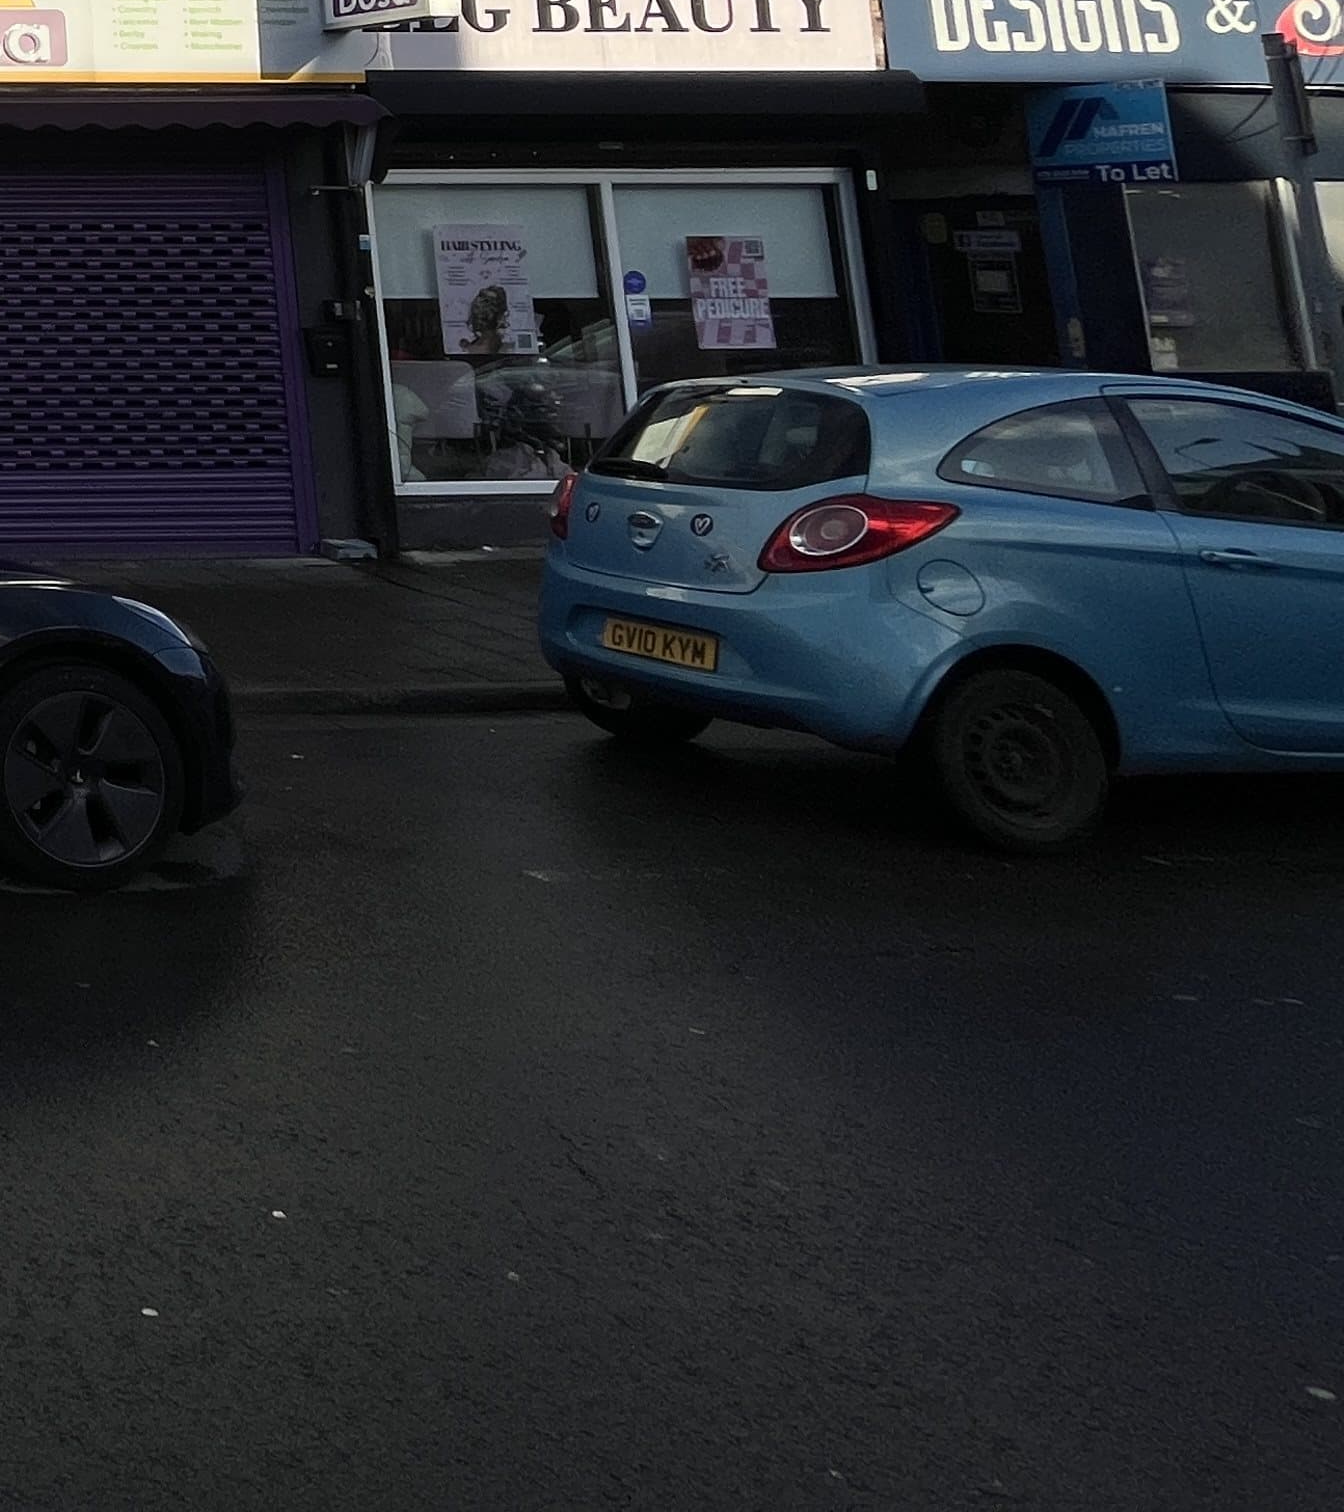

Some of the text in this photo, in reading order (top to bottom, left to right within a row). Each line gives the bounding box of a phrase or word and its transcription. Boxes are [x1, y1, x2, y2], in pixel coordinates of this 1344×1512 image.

[1095, 164, 1126, 182] To
[1131, 162, 1173, 182] Let
[709, 277, 747, 298] FREE
[696, 298, 770, 320] PEDICURE
[611, 623, 707, 665] GV10 KYM
